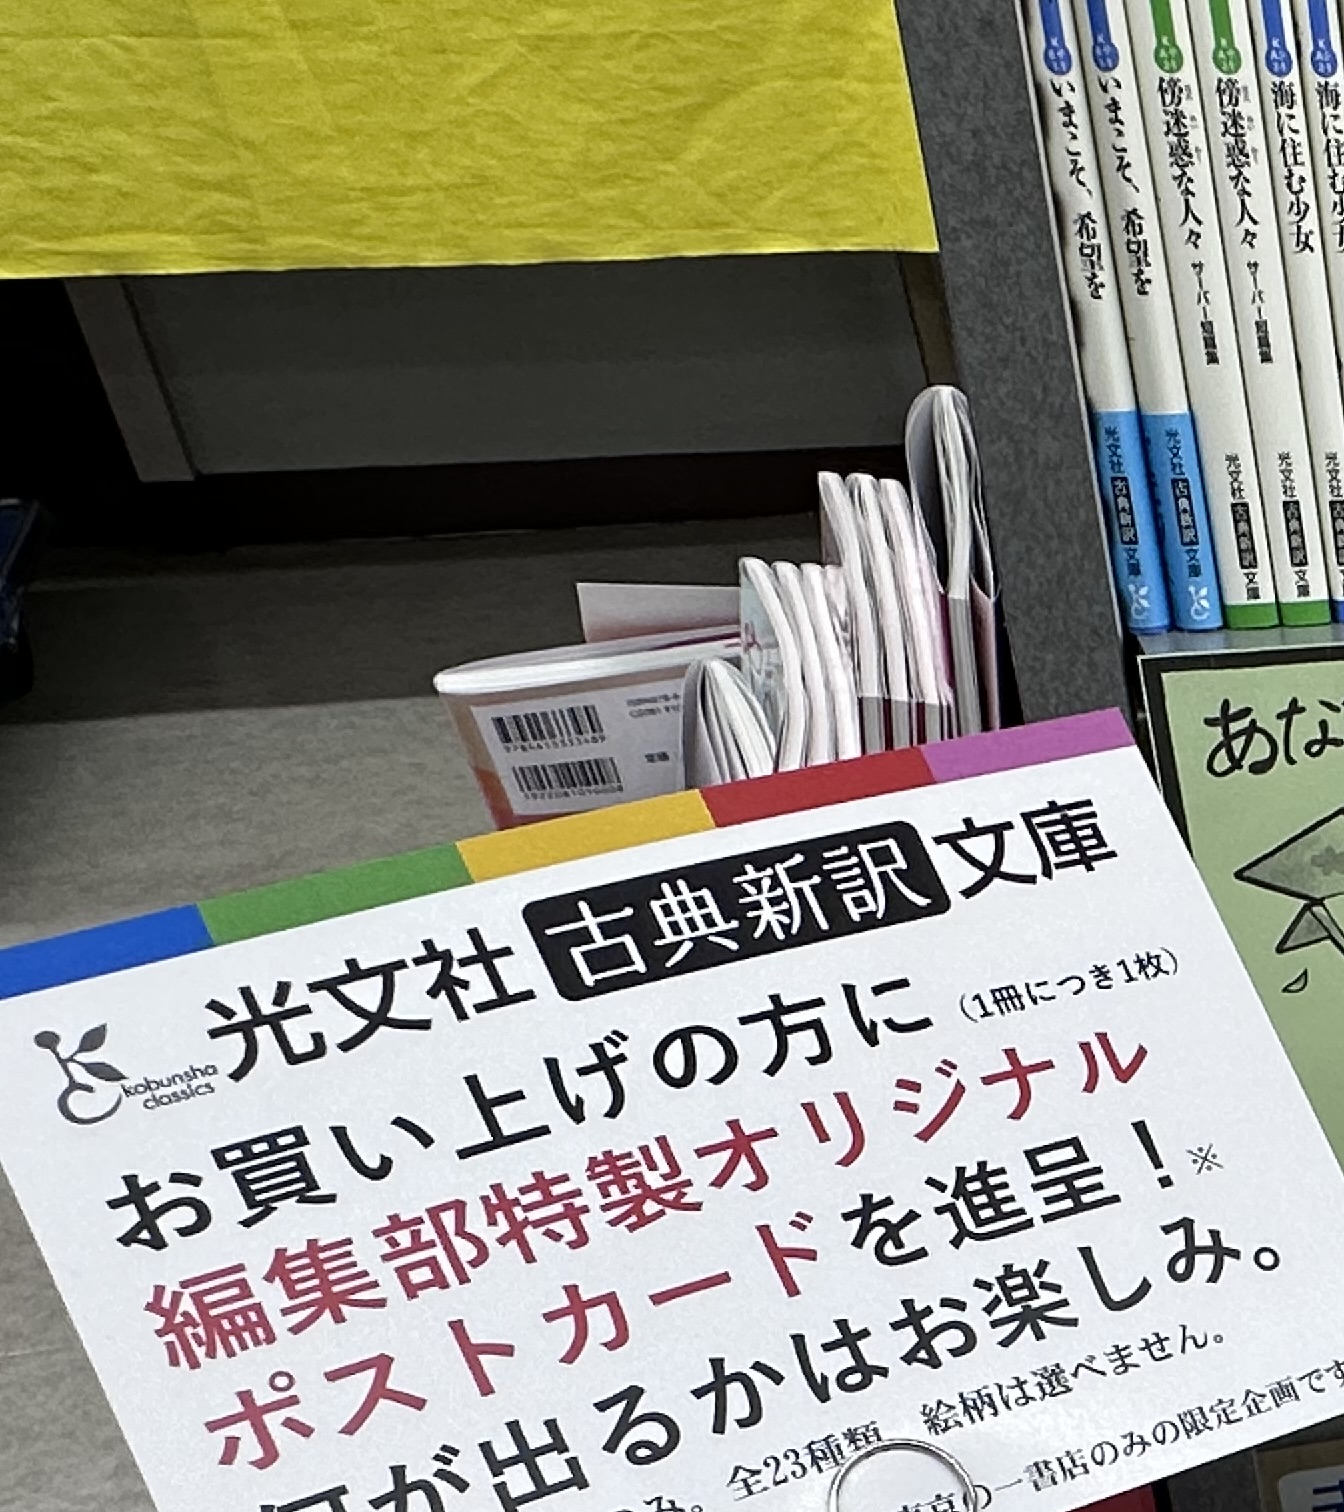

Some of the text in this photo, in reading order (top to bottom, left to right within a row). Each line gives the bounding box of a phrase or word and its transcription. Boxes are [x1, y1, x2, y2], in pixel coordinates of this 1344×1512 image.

[1271, 81, 1315, 254] 海に住む少女
[205, 797, 1119, 1081] 光文社古典新訳文庫
[105, 977, 933, 1252] お買い上げの方に
[121, 1061, 219, 1099] kobunsha
[142, 1081, 216, 1112] classics
[144, 1030, 1150, 1371] 編集部特製オリジナル
[919, 1324, 1228, 1437] 絵柄は選べません。
